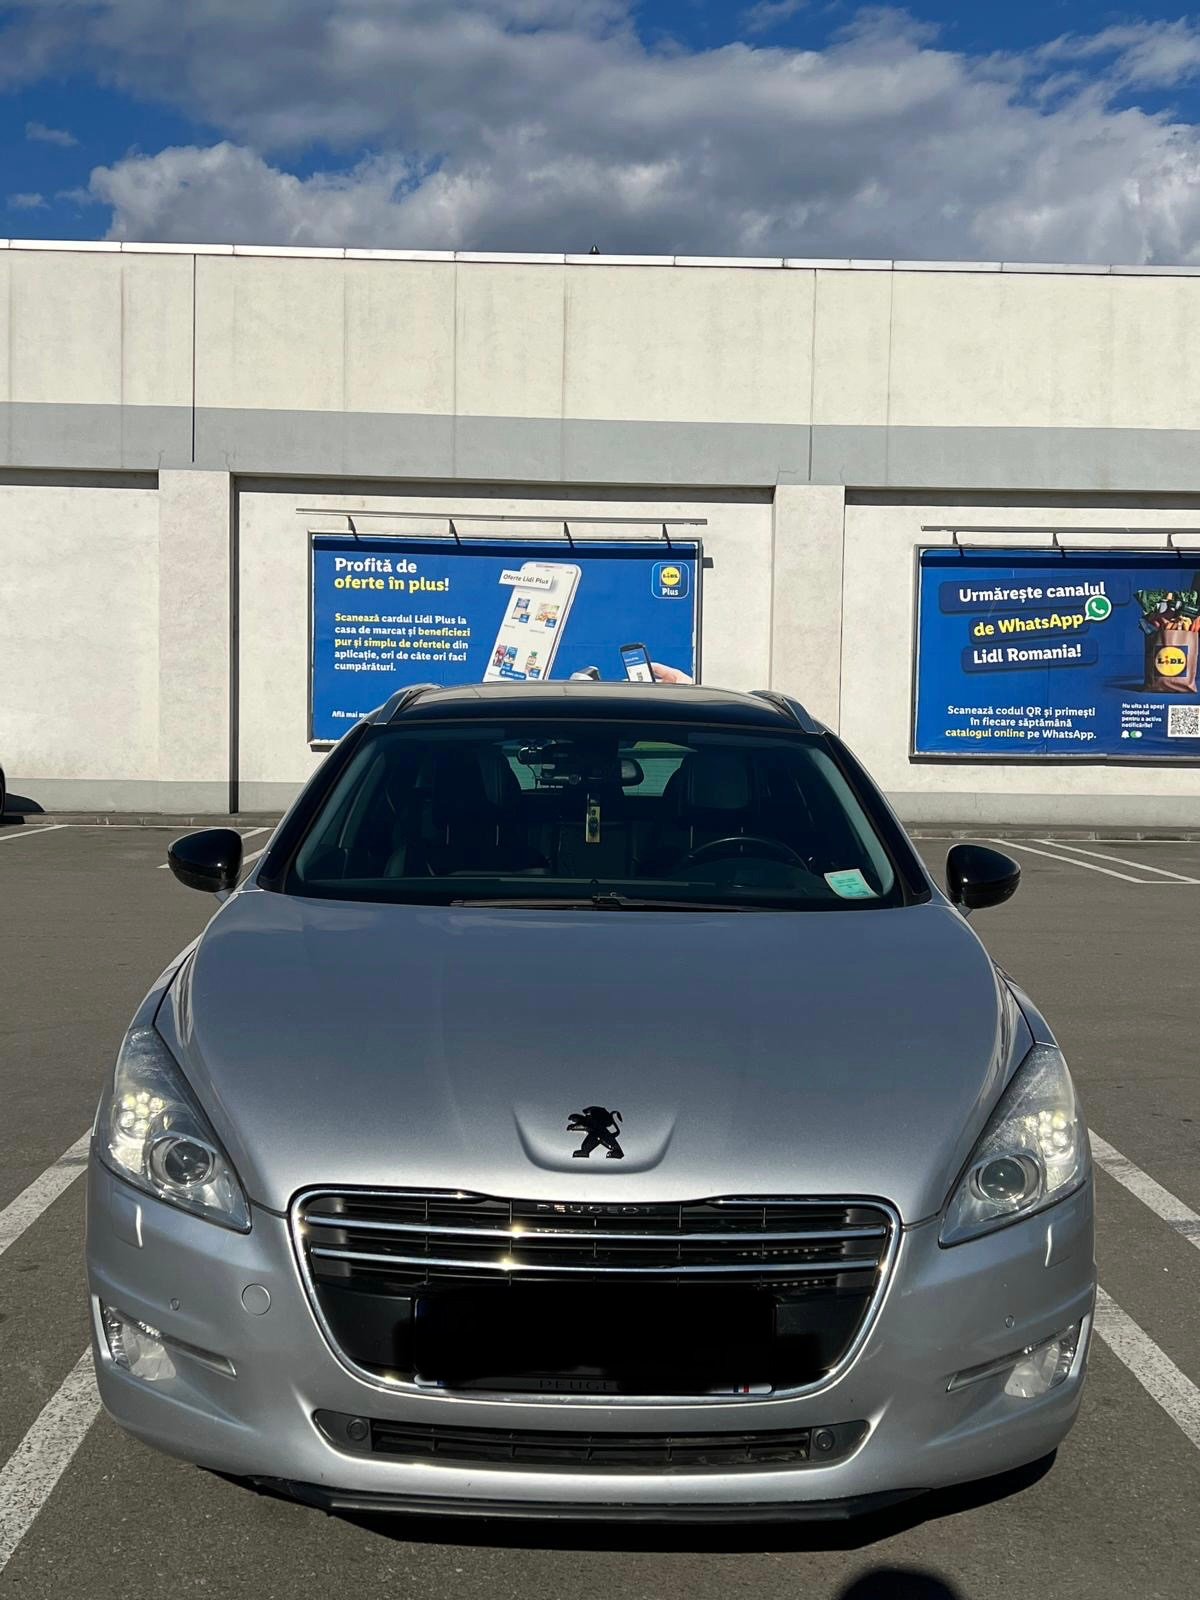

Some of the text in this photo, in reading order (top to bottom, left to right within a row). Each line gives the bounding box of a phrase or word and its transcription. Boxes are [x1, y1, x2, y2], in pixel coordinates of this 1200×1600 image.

[335, 558, 417, 573] Profită de
[334, 575, 449, 593] oferte în plus!
[503, 573, 522, 583] Oferte
[535, 575, 549, 585] Plus
[959, 581, 1106, 603] Urmărește canalul
[335, 613, 466, 625] Scanează cardul Lidl Plus la
[974, 614, 1084, 636] de WhatsApp
[335, 625, 471, 637] casa de marcat și beneficiezi
[335, 637, 468, 649] pur și simplu de ofertele din
[334, 650, 466, 661] aplicație, ori de câte ori faci
[973, 644, 1082, 664] Lidl Romania!
[334, 662, 396, 673] cumpărături.
[947, 705, 1095, 718] Scanează codul QR și primești
[970, 717, 1072, 728] în fiecare săptămână
[945, 728, 1097, 740] catalogul online pe WhatsApp.
